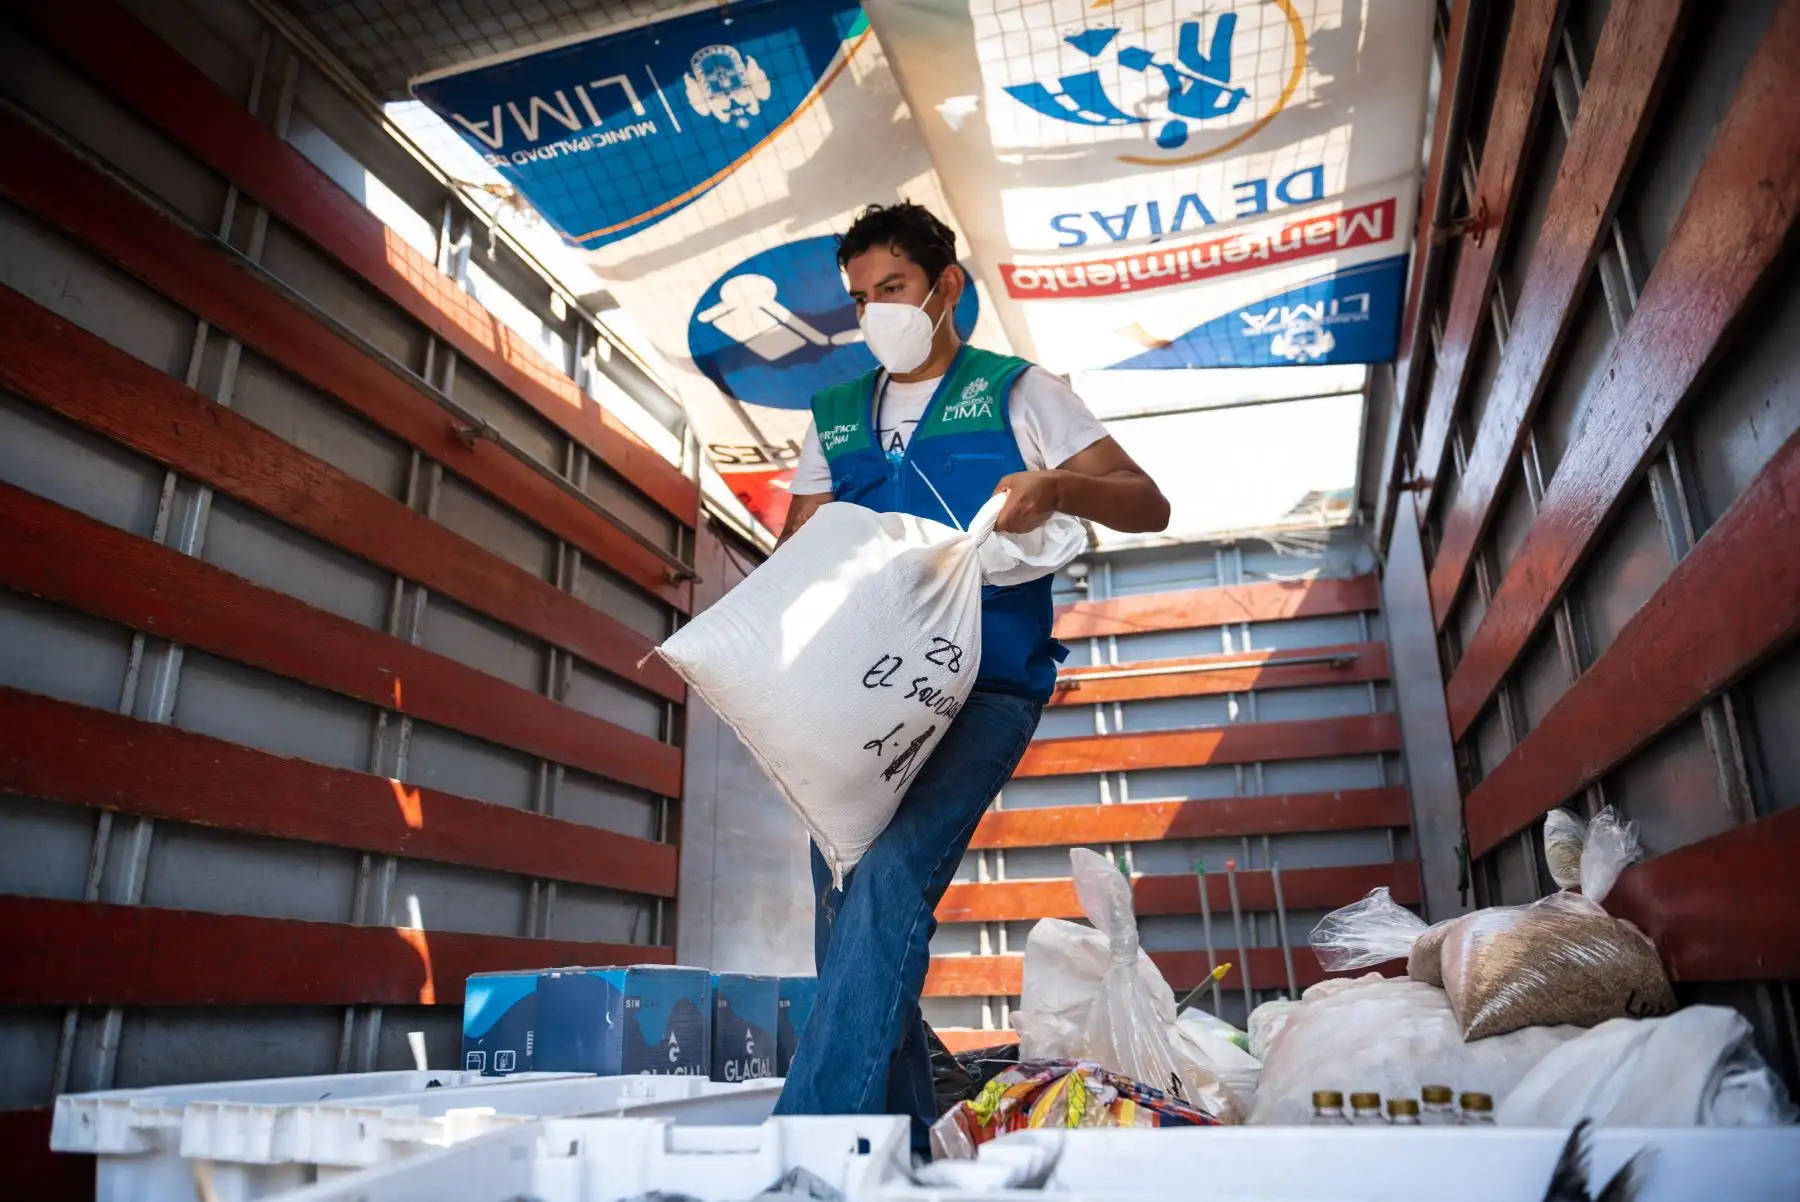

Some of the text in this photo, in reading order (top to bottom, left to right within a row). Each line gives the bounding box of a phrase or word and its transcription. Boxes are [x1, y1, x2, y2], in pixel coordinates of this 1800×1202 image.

[452, 74, 646, 149] LIMA
[511, 119, 657, 166] MUNICIPALIDAD
[1232, 164, 1325, 219] DE
[1011, 207, 1384, 292] Mantenimiento
[1240, 293, 1370, 329] LIMA
[942, 402, 993, 421] LIMA
[925, 637, 962, 673] 28
[724, 1057, 772, 1082] GLACIAL
